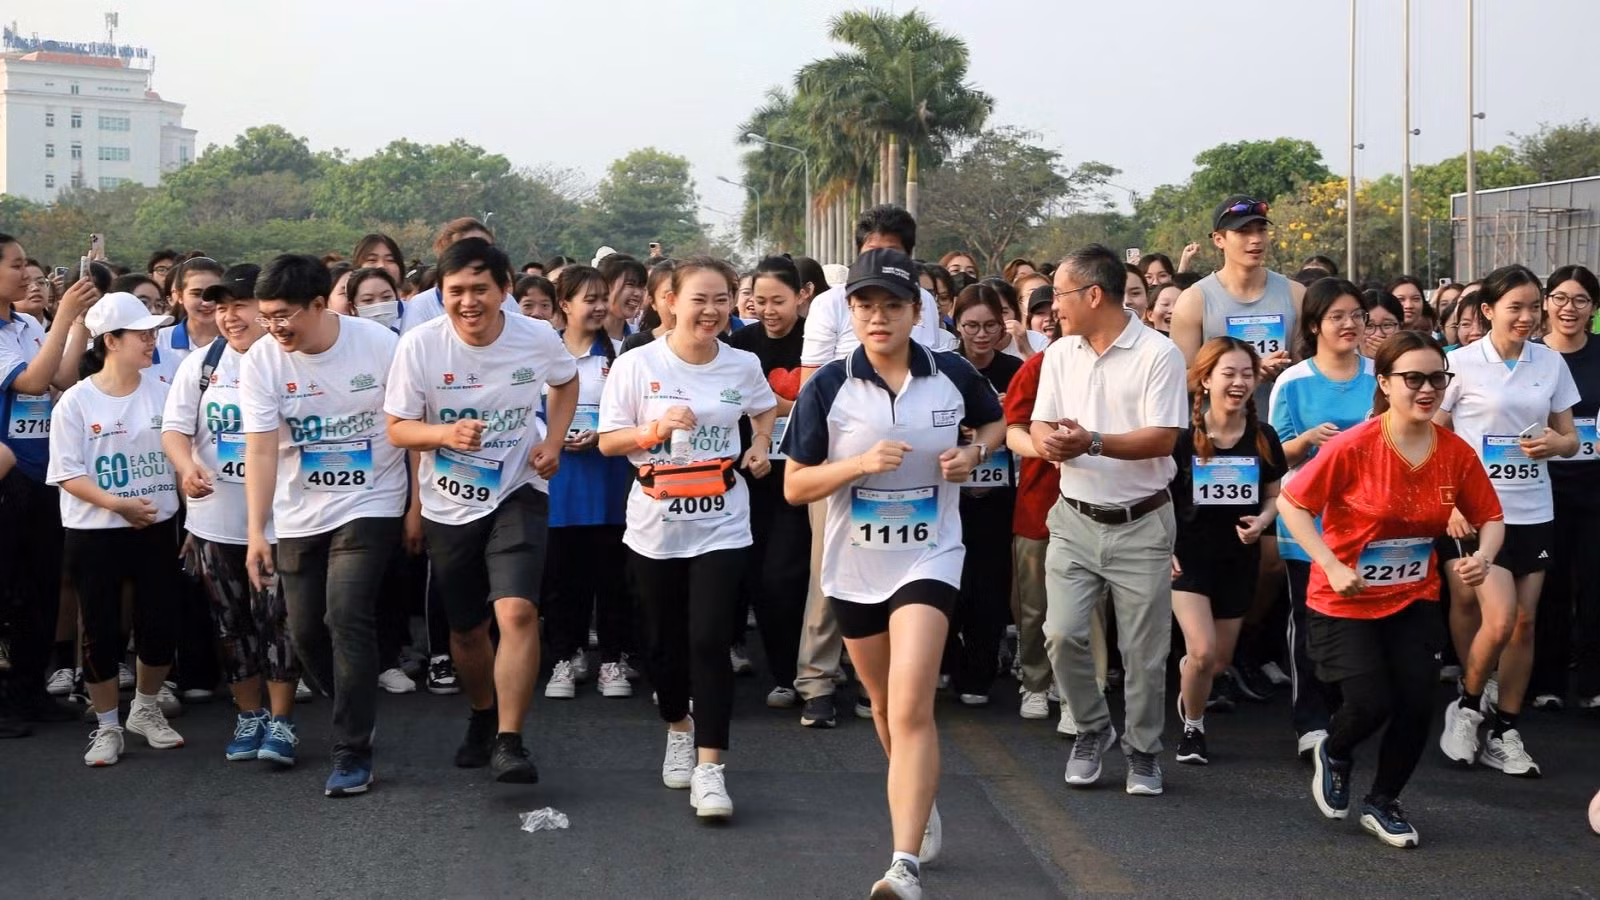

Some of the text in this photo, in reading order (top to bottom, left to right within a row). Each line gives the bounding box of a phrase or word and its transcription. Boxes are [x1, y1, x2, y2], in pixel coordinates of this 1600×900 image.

[15, 418, 51, 434] 3718
[130, 451, 168, 467] EART
[95, 452, 129, 491] 60
[222, 461, 246, 478] 40
[307, 469, 366, 486] 4028
[968, 468, 1003, 482] 126
[1488, 463, 1540, 480] 2955
[437, 476, 490, 502] 4039
[1199, 484, 1253, 499] 1336
[668, 495, 725, 514] 4009
[860, 522, 929, 544] 1116
[1363, 561, 1421, 581] 2212
